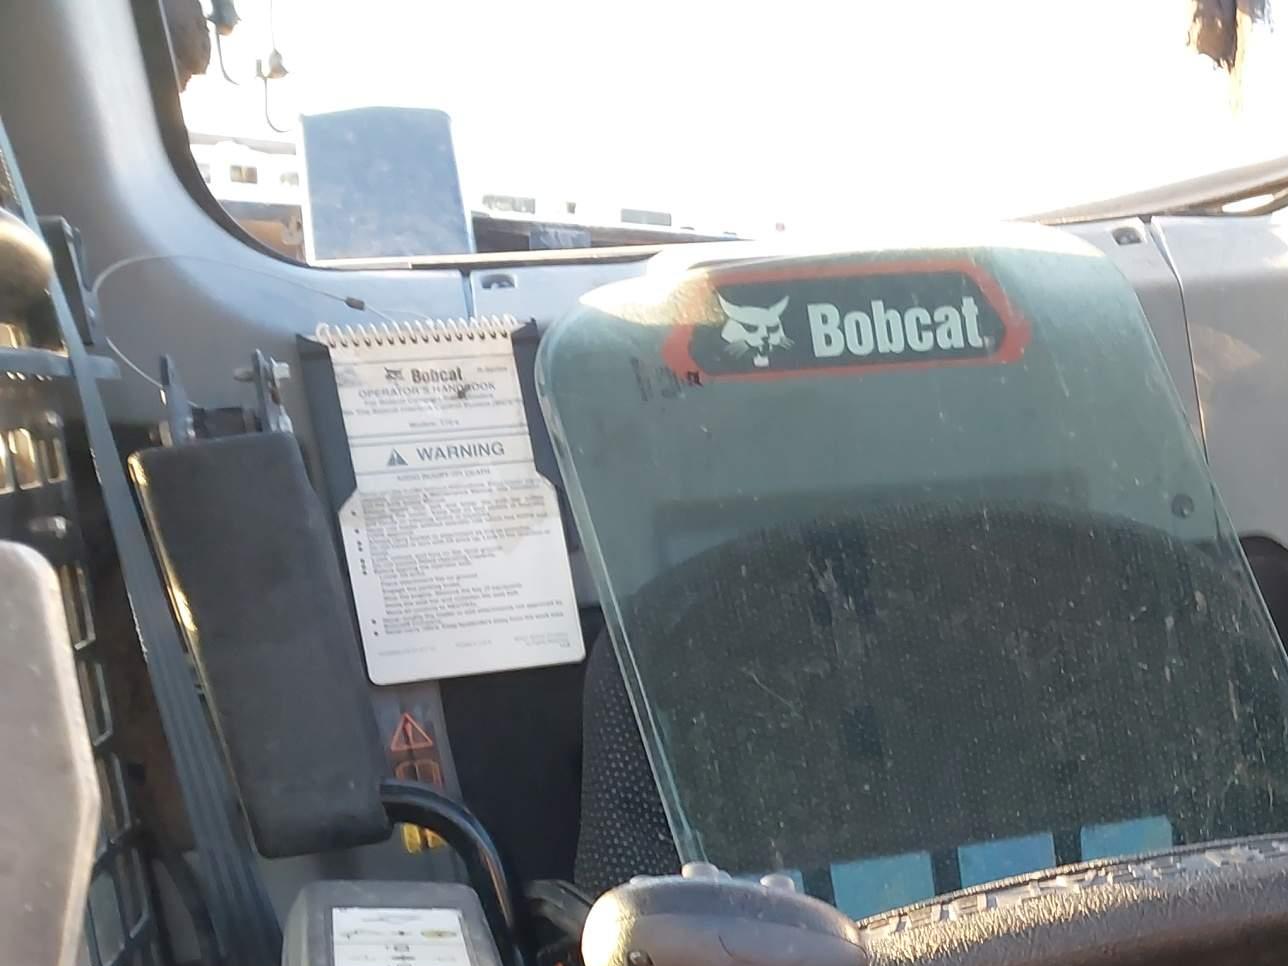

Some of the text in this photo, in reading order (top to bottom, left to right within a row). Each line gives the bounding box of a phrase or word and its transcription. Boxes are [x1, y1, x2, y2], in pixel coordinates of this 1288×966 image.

[807, 296, 984, 358] Bobcat
[410, 366, 464, 385] Bobcat
[416, 442, 505, 462] WARNING
